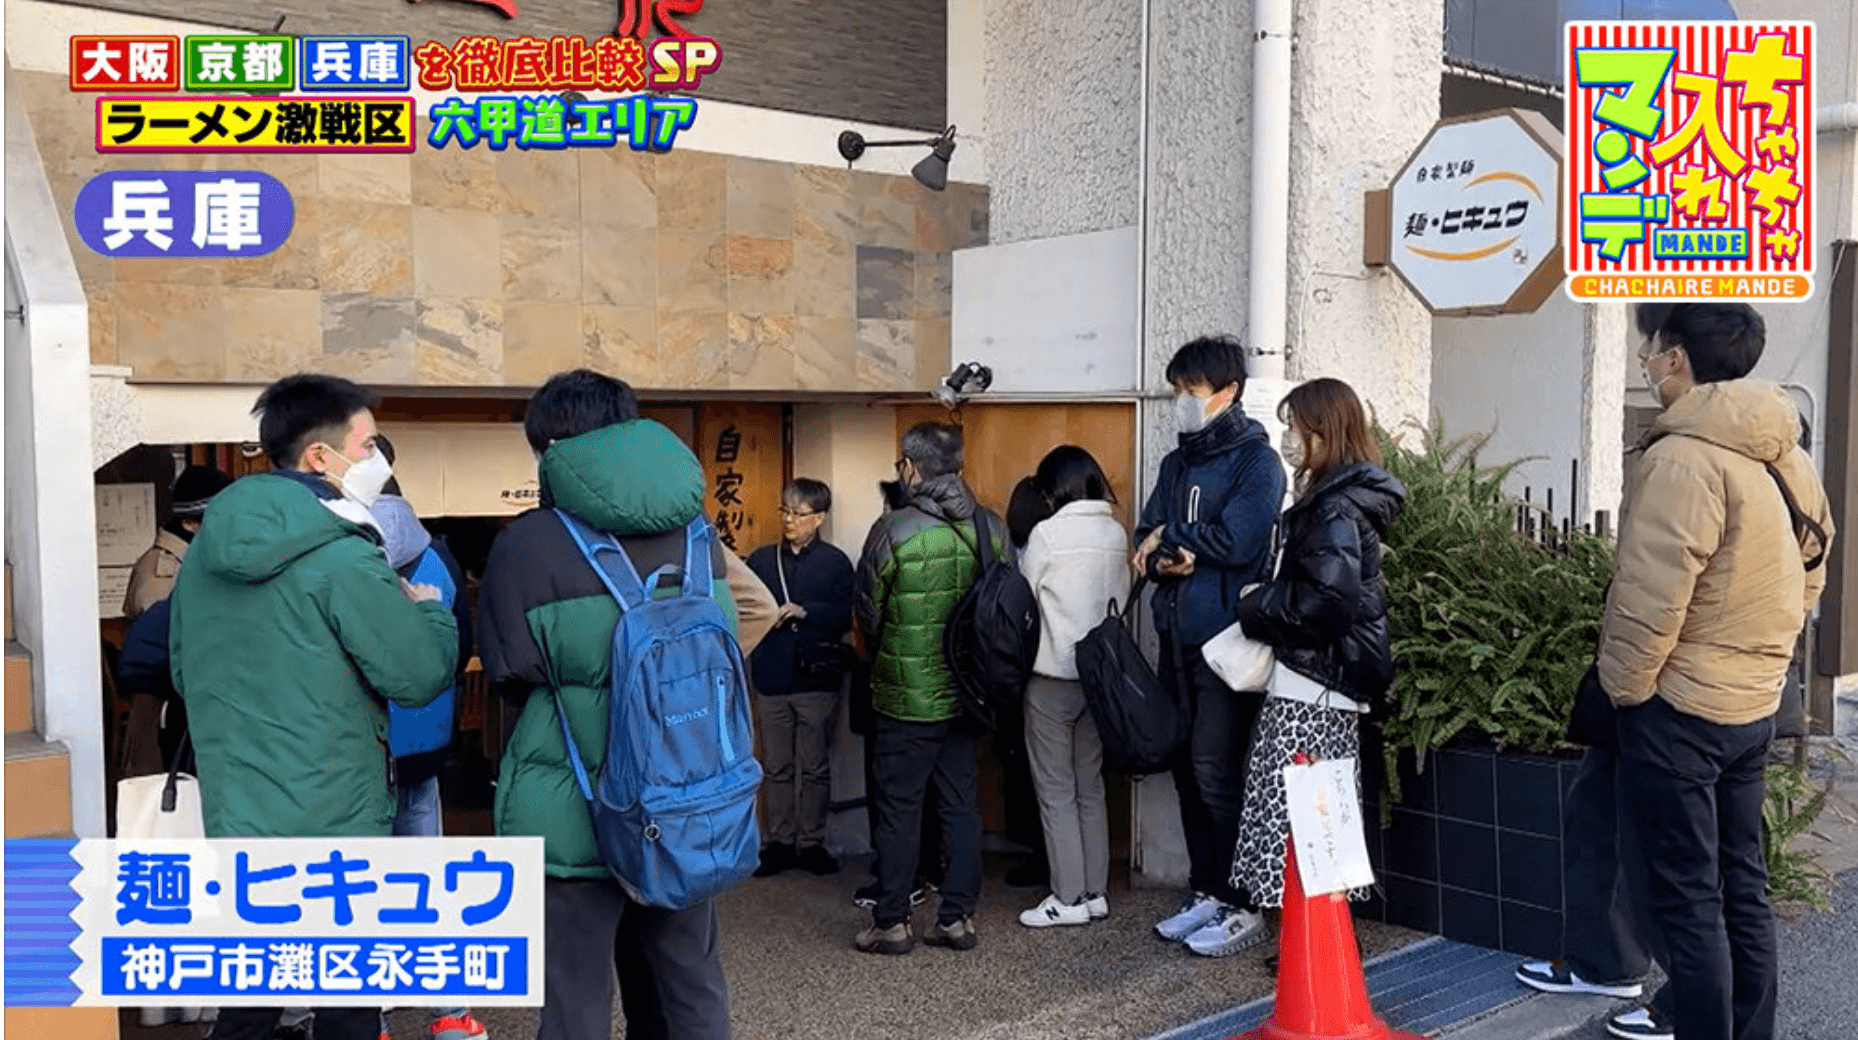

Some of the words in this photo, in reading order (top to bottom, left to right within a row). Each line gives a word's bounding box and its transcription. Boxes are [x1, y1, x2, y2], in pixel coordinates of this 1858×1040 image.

[1403, 200, 1530, 239] 麺・ヒキュウ
[714, 424, 750, 563] 自家製
